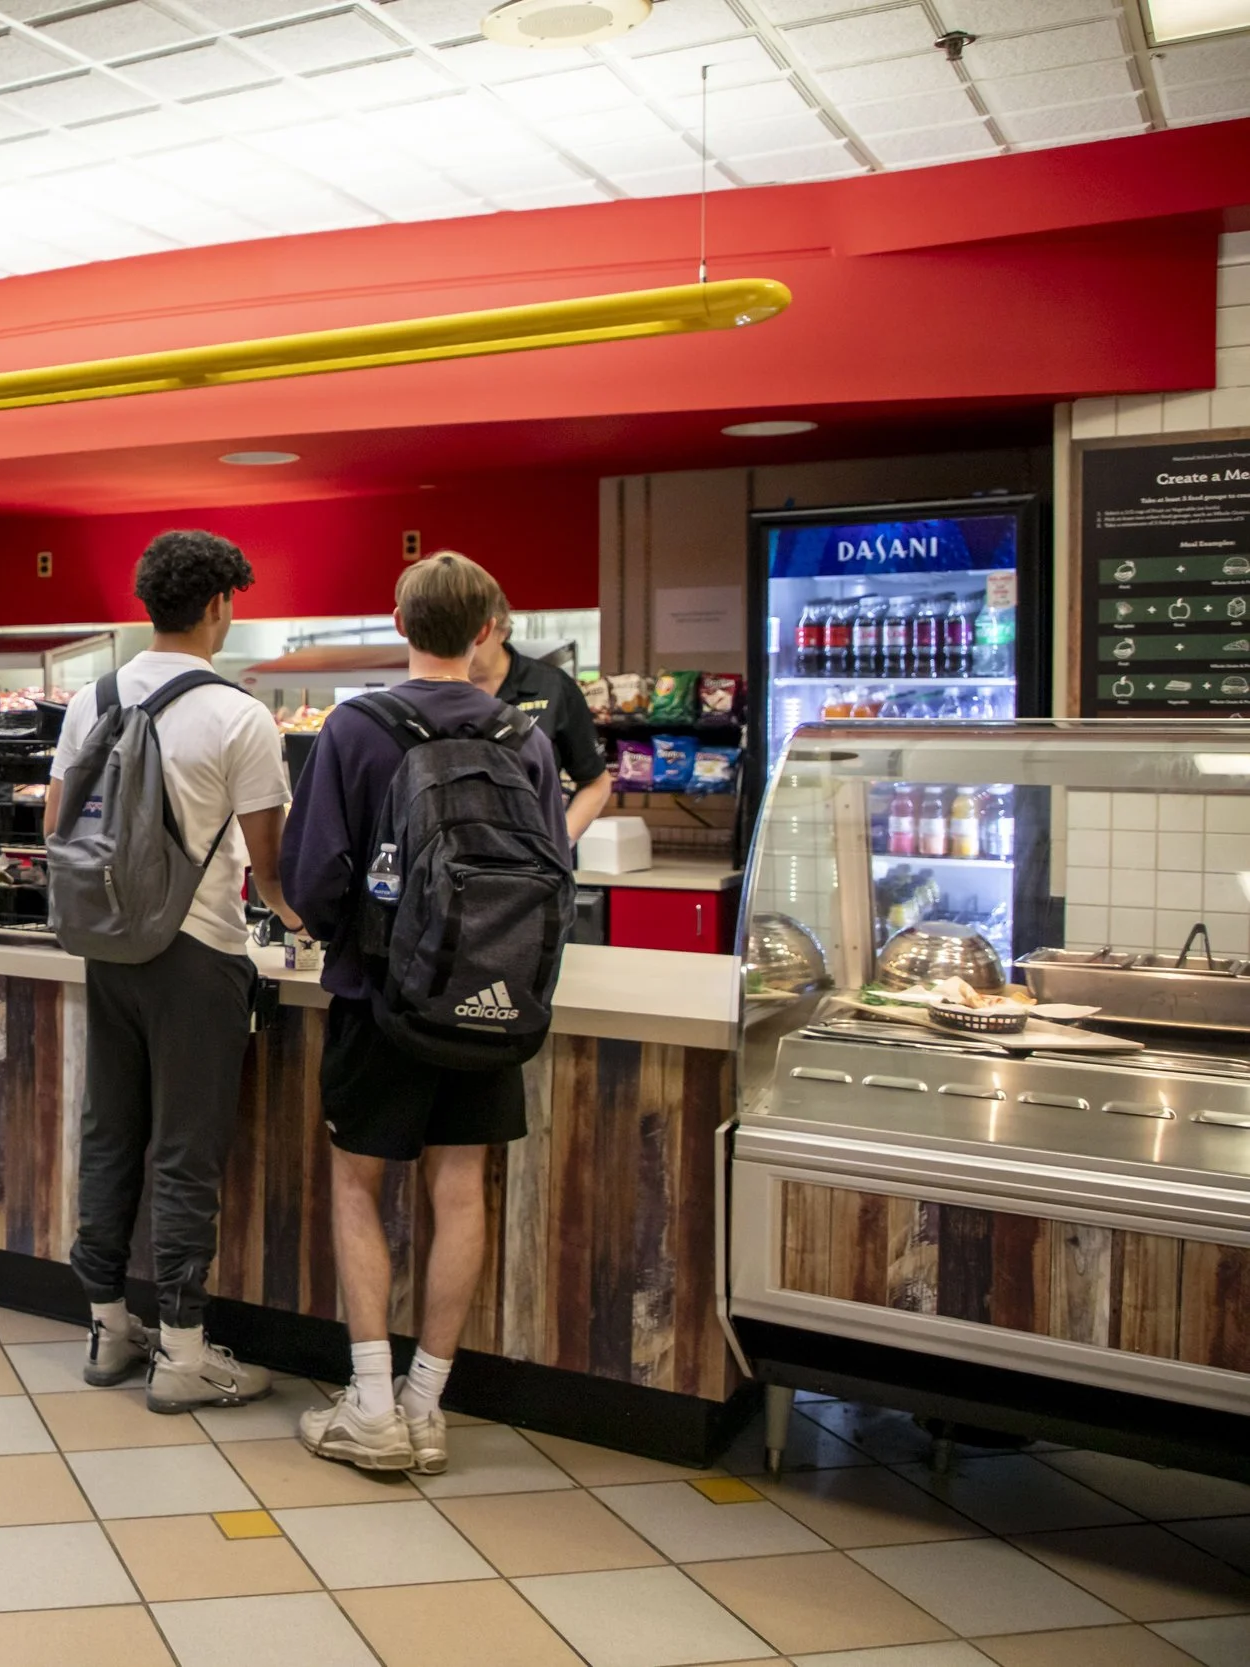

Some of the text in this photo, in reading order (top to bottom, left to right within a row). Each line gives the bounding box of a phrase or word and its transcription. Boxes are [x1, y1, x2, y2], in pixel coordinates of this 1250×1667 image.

[1156, 473, 1208, 485] Create
[1211, 473, 1222, 482] a
[837, 534, 938, 564] DASANI
[454, 1004, 519, 1020] adidas
